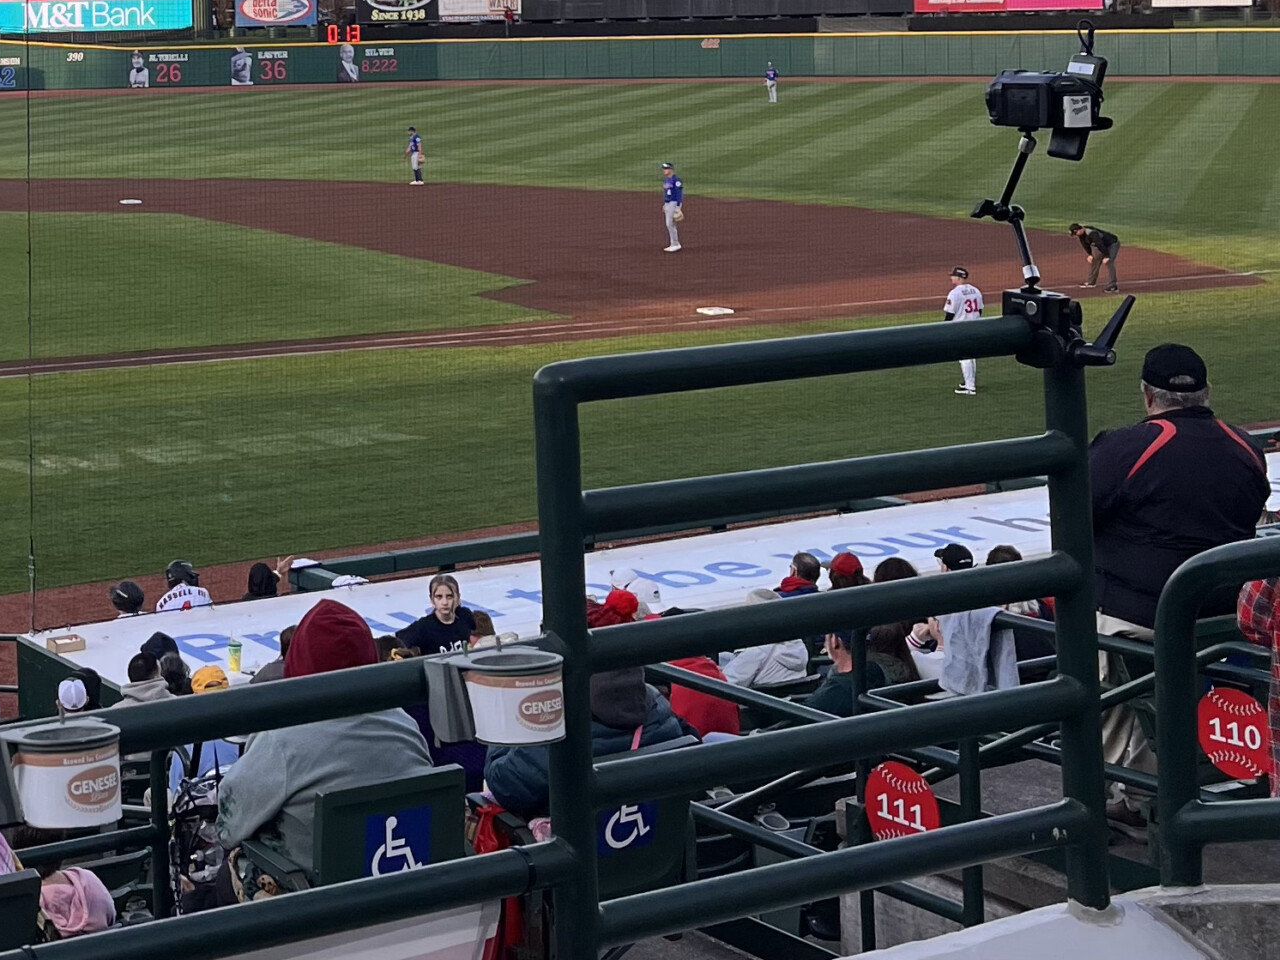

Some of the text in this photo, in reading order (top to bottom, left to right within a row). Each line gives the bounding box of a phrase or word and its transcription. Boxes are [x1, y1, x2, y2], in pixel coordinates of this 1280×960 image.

[22, 0, 156, 28] M&T Bank
[372, 9, 426, 21] SINCE 1938
[66, 52, 84, 62] 390
[364, 48, 394, 57] SILVER
[156, 63, 182, 83] 26
[260, 60, 287, 80] 36
[361, 59, 398, 74] 8,222
[964, 298, 979, 314] 31
[632, 561, 772, 589] be
[159, 589, 192, 610] HASSELL
[1208, 716, 1261, 750] 110
[71, 772, 118, 795] GENESEE
[876, 792, 927, 831] 111
